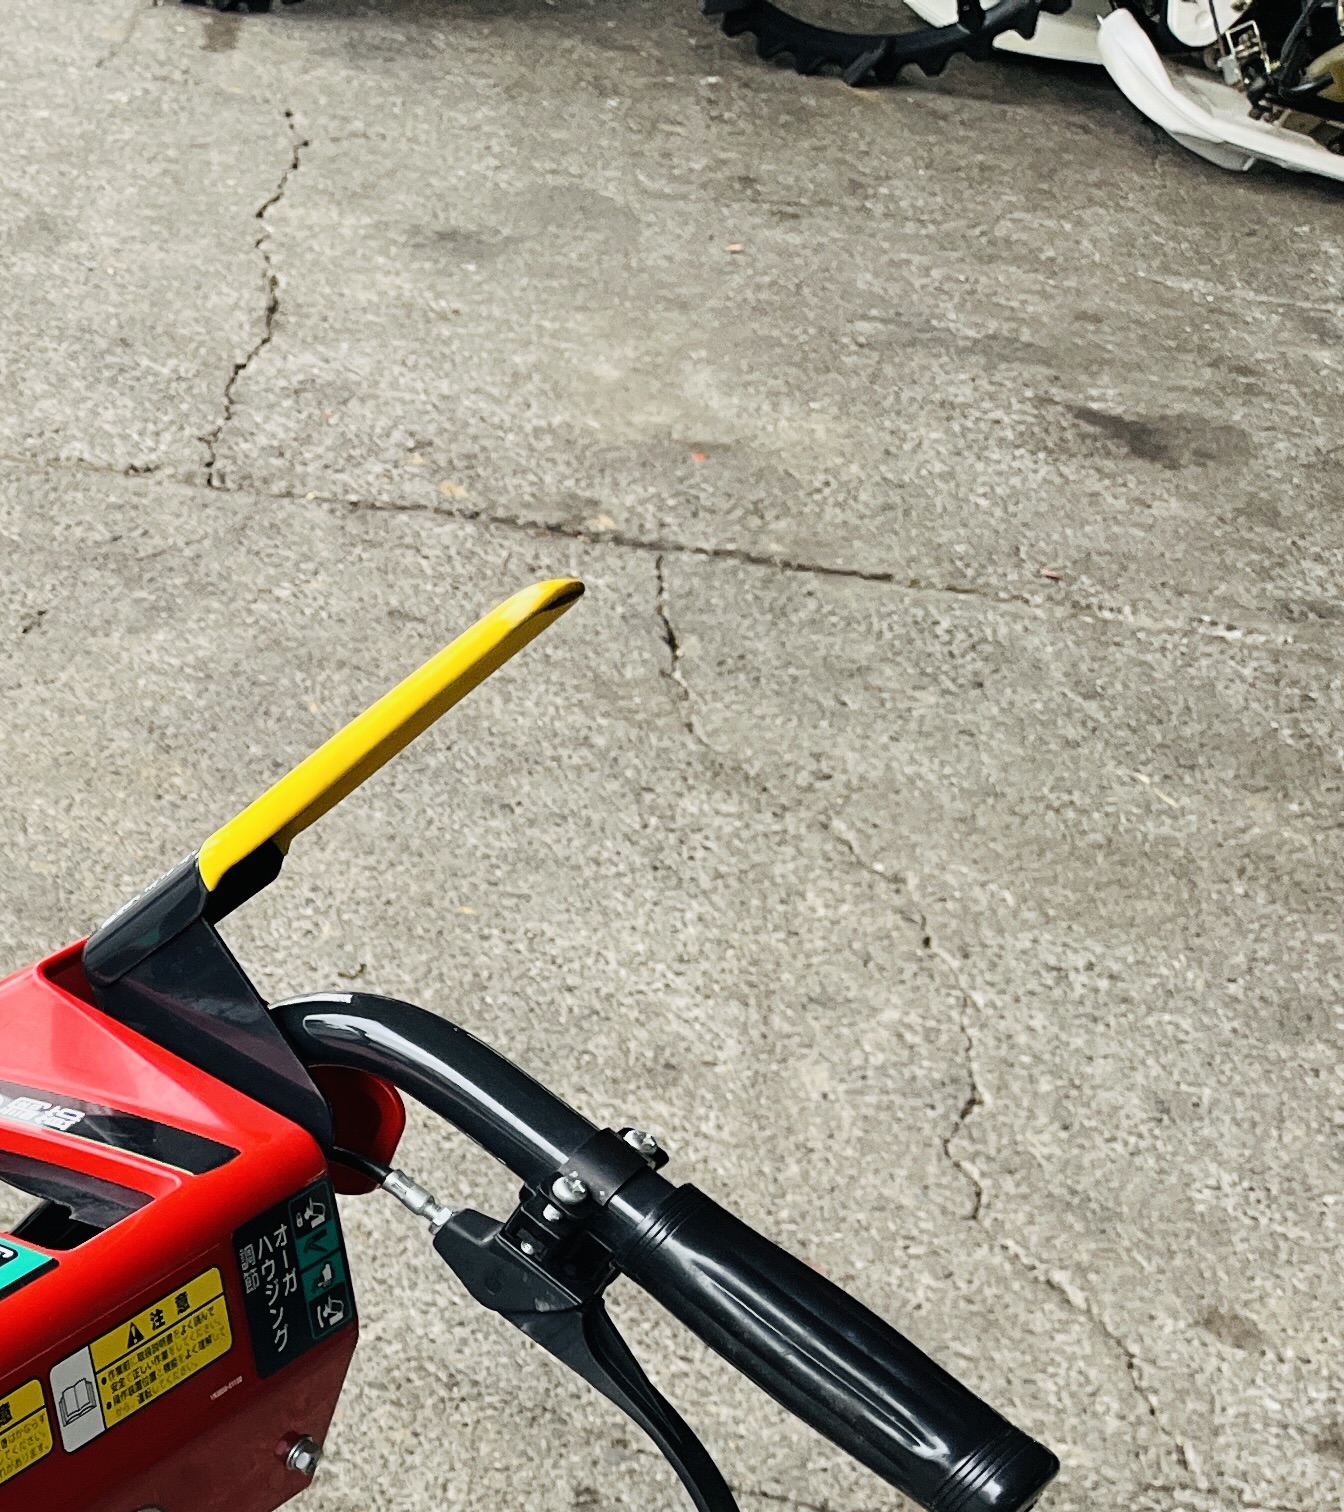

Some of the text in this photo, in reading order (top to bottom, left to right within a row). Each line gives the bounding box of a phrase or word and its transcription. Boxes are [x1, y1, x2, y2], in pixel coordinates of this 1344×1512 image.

[239, 1243, 260, 1295] 調節
[273, 1223, 299, 1296] オーガ
[149, 1289, 190, 1332] 注意
[258, 1235, 289, 1353] ハウジング
